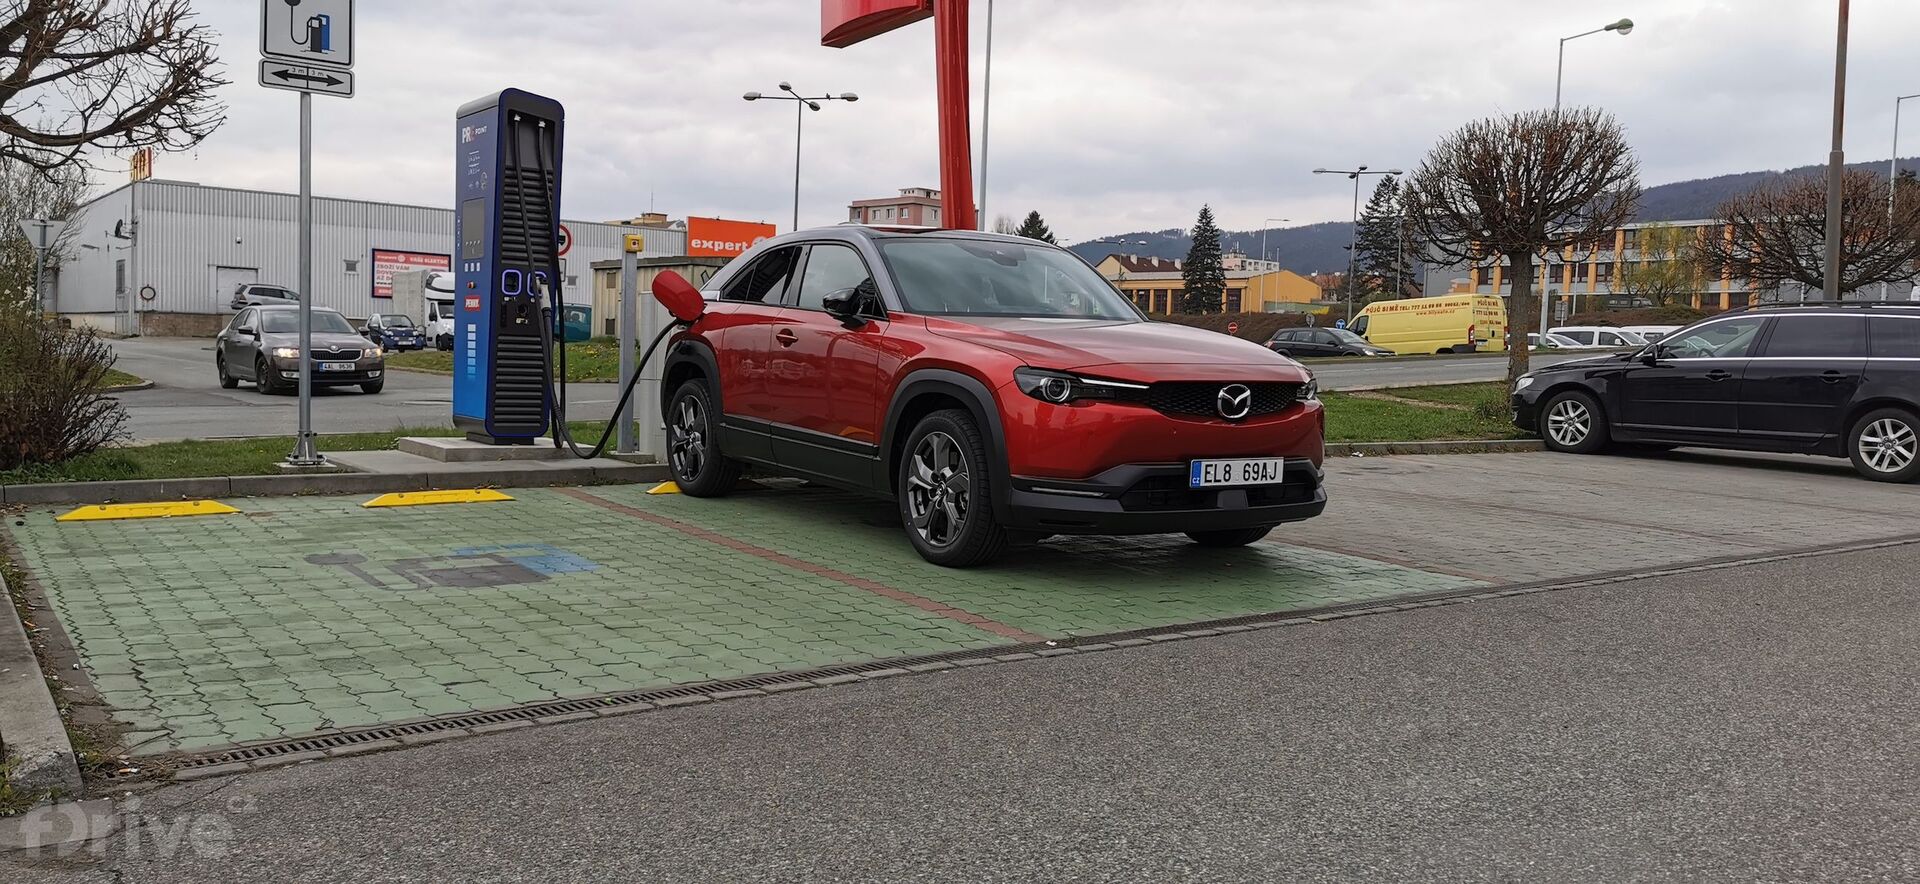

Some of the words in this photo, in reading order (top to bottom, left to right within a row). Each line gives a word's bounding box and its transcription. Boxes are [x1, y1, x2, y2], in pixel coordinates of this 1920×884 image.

[691, 239, 748, 251] expert
[1204, 463, 1232, 483] EL8
[1243, 461, 1278, 481] 69AJ
